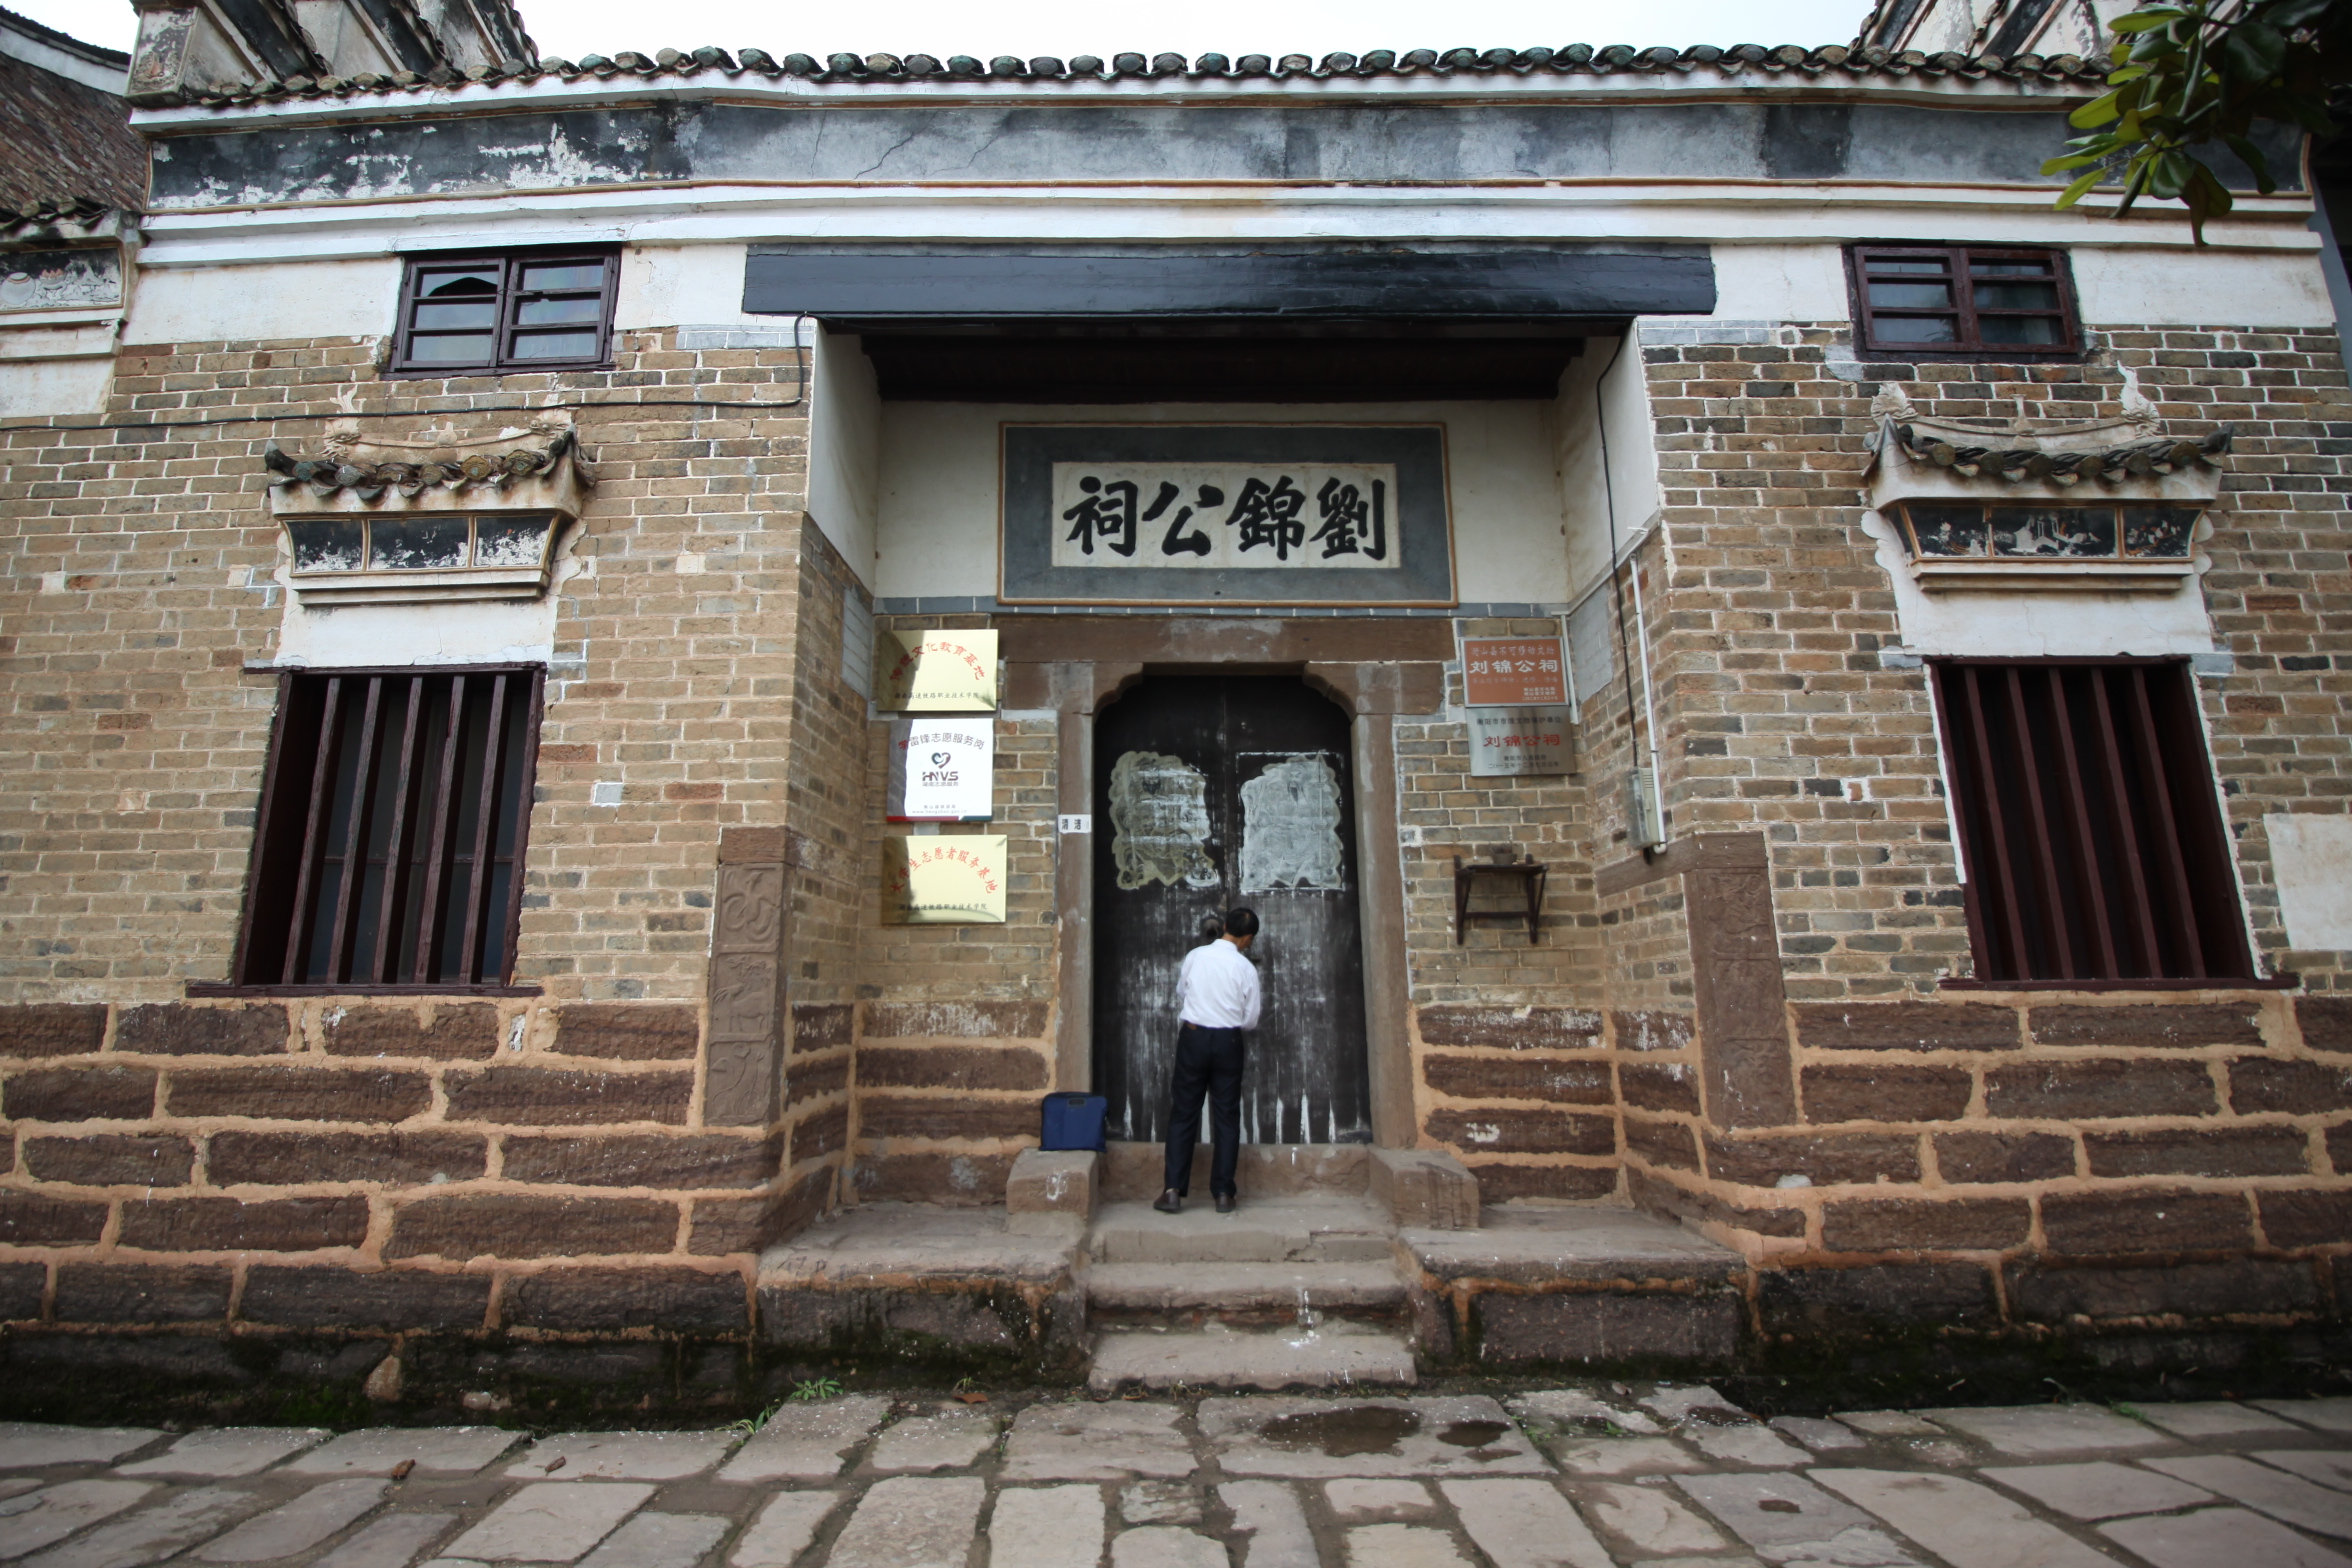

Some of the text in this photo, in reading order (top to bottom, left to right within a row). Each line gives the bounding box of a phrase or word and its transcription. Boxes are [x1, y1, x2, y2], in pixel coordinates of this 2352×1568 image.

[1468, 659, 1559, 674] 刘锦公祠
[898, 732, 985, 750] 学雷锋志愿服务岗
[1482, 734, 1561, 748] 刘锦公祠
[922, 771, 959, 782] HNVS
[890, 846, 998, 894] 大学生志愿者服务基地
